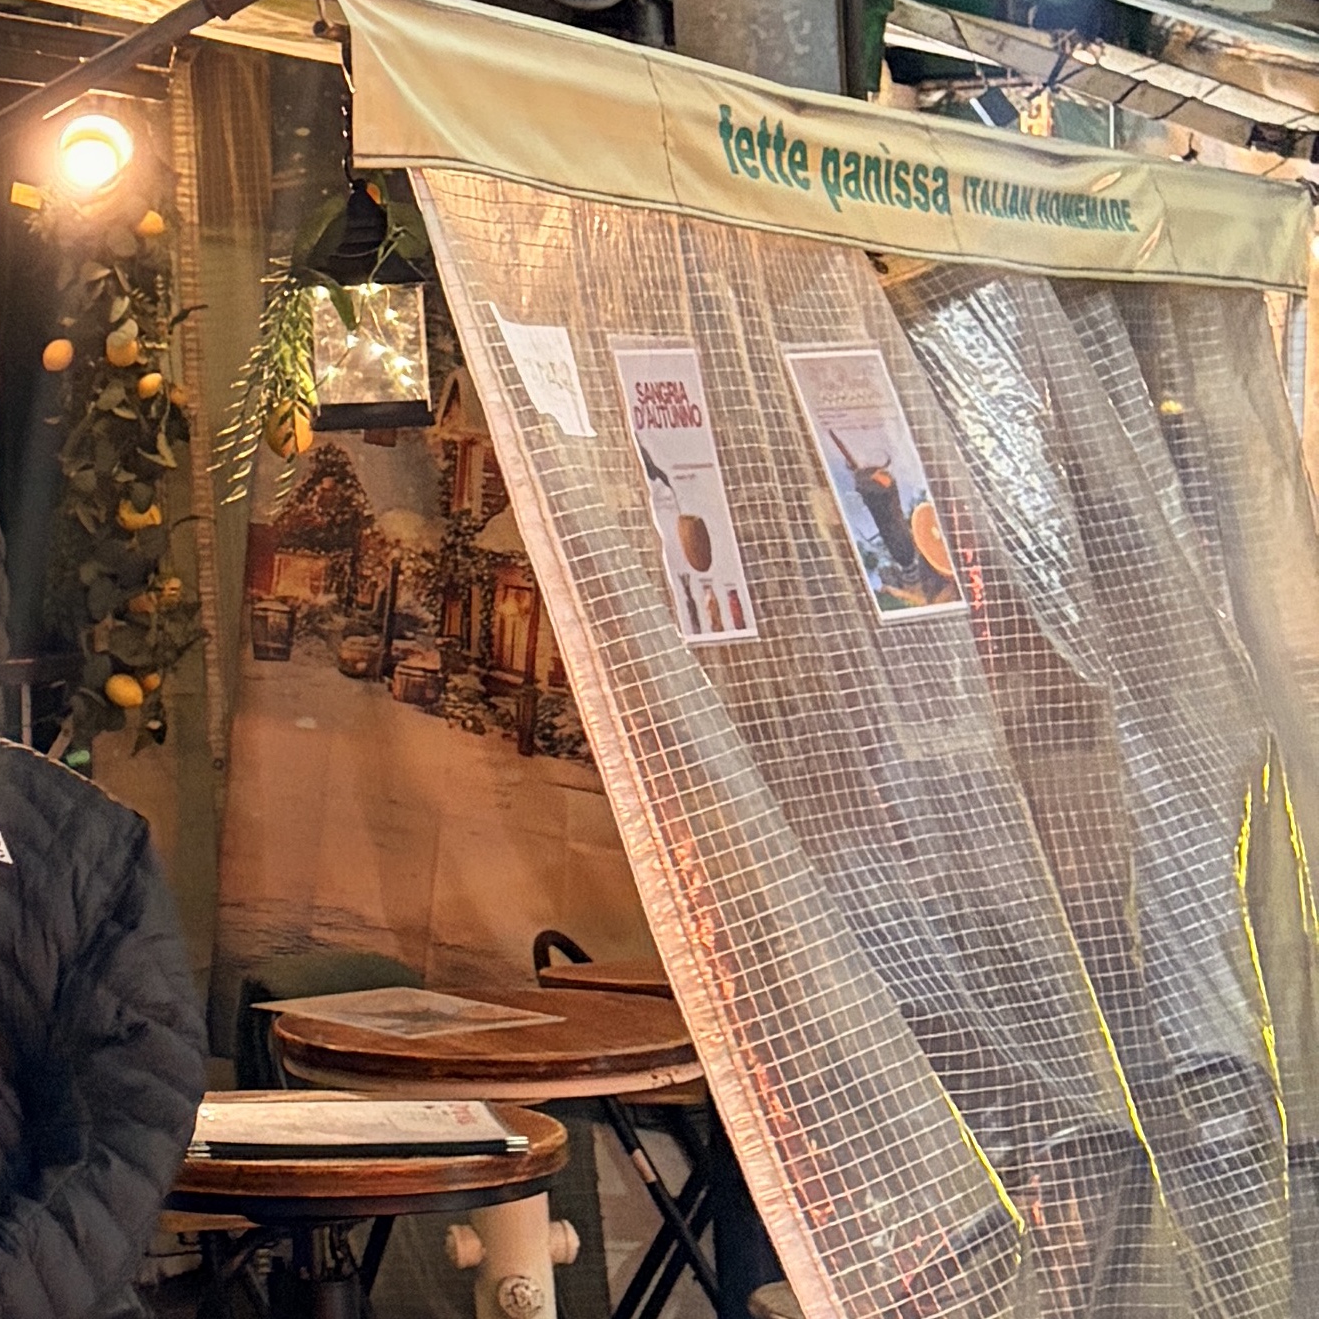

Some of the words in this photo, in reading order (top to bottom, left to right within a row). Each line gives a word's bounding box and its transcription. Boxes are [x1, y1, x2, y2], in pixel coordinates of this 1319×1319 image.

[718, 103, 811, 191] fette
[820, 141, 951, 216] panissa
[961, 174, 1033, 222] ITALIAN
[1035, 186, 1141, 234] HOMEMADE
[634, 380, 689, 405] SANGRIA
